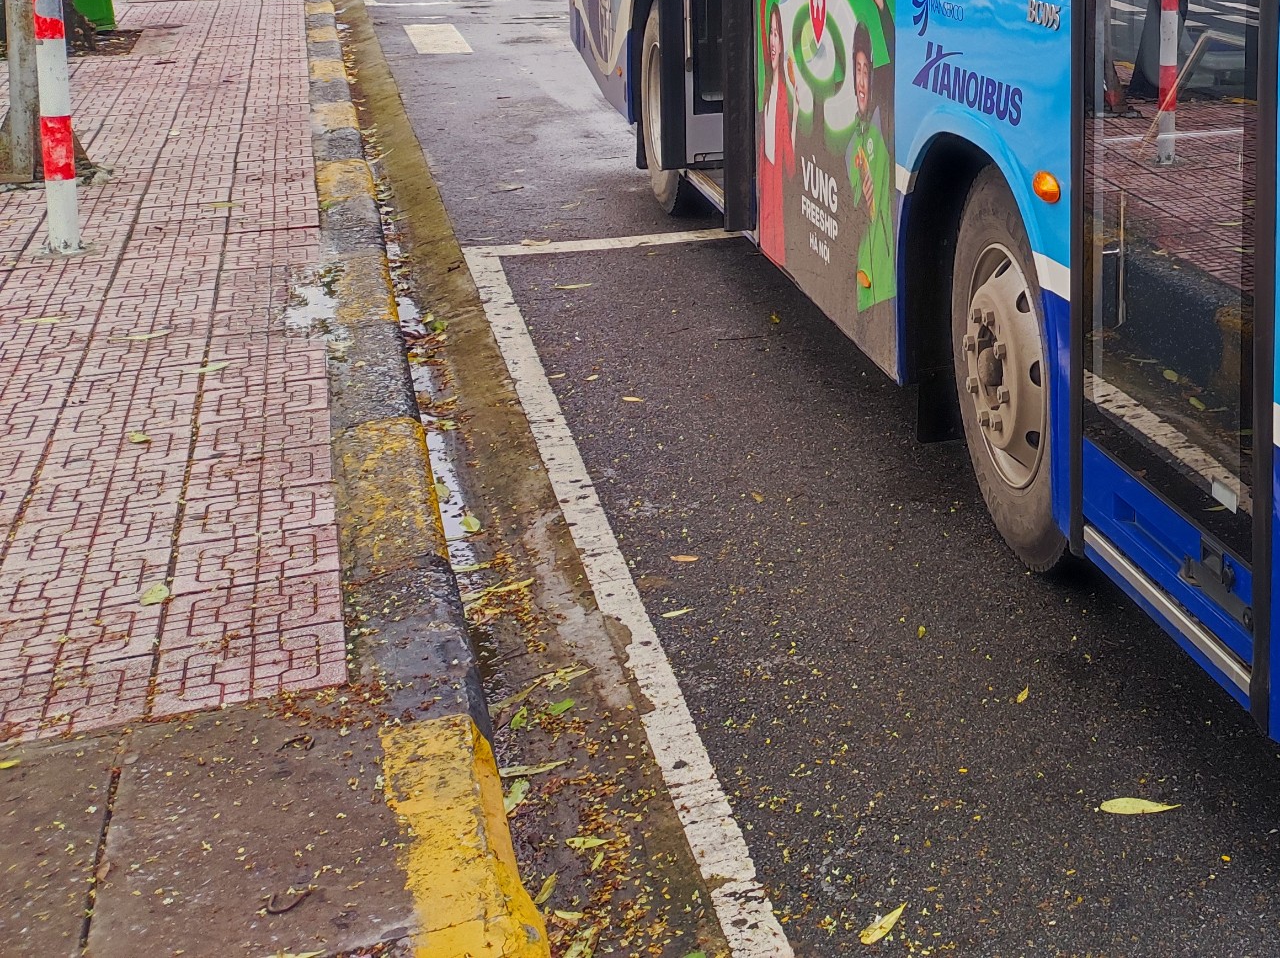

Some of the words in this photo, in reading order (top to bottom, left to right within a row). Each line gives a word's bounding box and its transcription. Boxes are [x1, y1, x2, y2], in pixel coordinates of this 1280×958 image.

[912, 41, 1023, 126] HANOIBUS
[801, 154, 838, 213] VÙNG
[801, 194, 839, 240] FREESHIP
[809, 231, 819, 254] HÀ
[818, 240, 830, 266] NỘI
